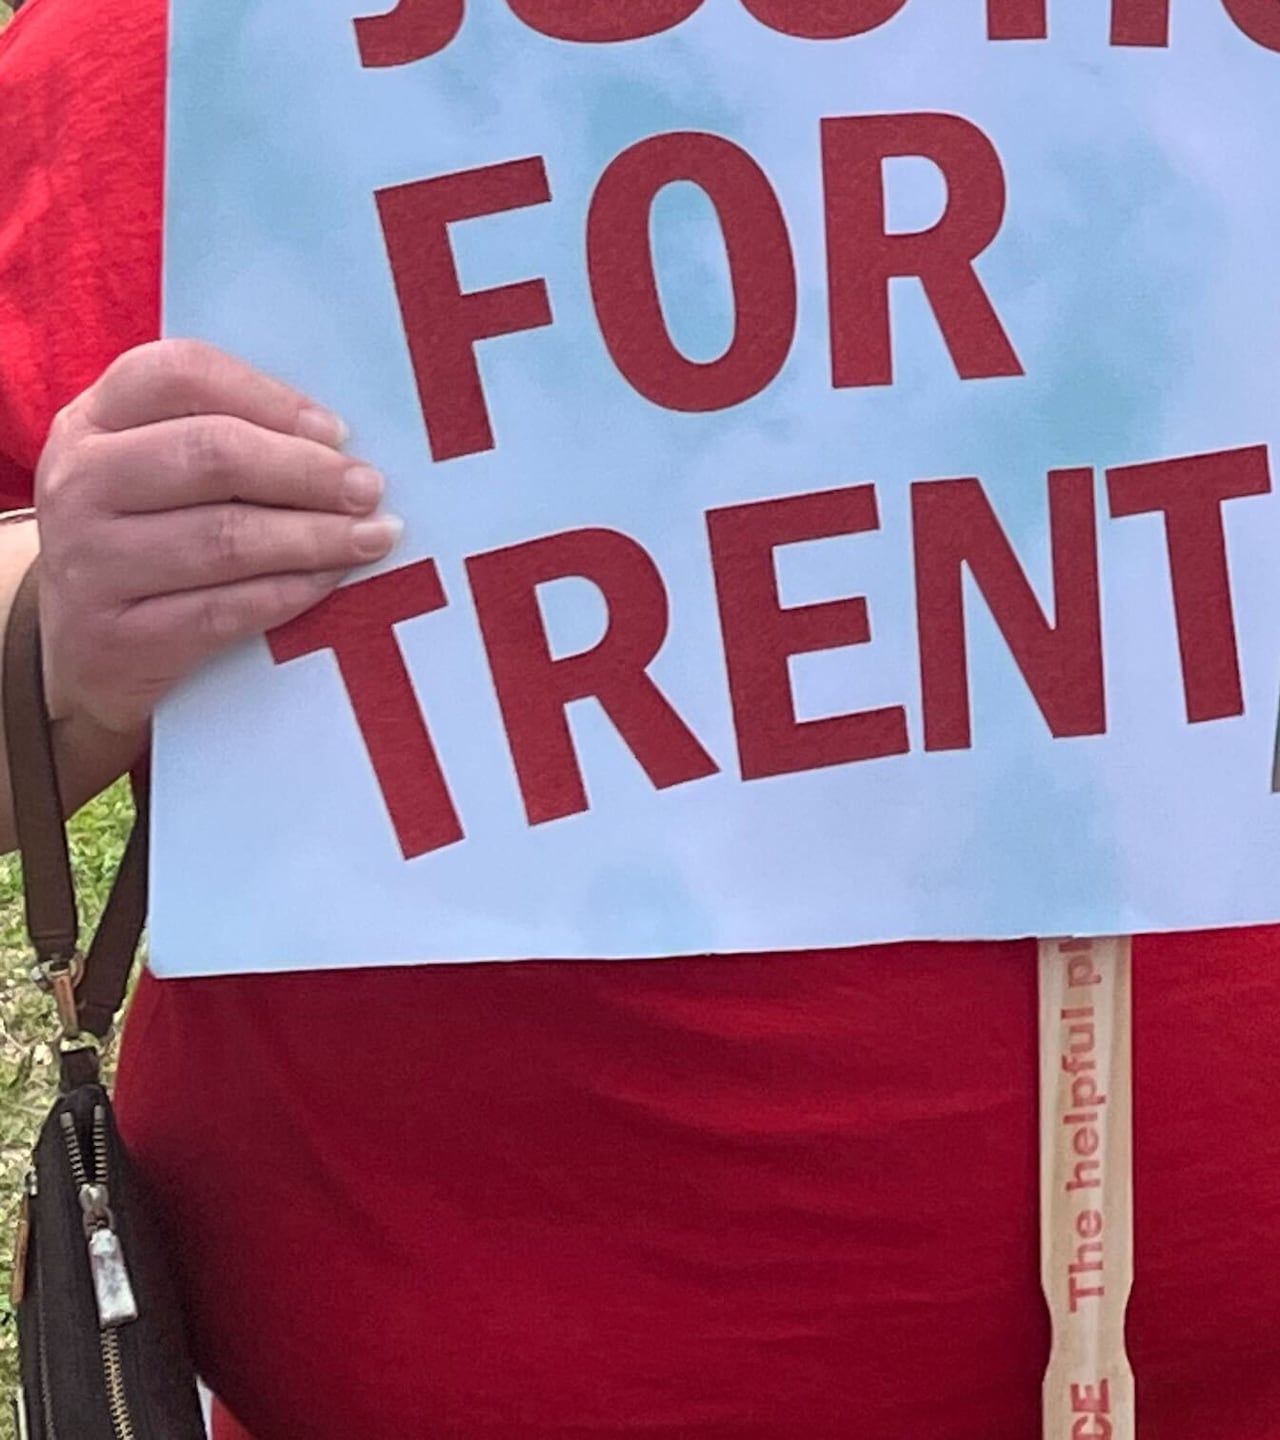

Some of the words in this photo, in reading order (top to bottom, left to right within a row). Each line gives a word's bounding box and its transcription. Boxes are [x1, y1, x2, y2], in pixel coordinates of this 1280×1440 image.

[374, 112, 1022, 460] FOR
[269, 444, 1272, 861] TRENT
[1060, 1005, 1107, 1193] helpful
[1068, 1210, 1105, 1314] The
